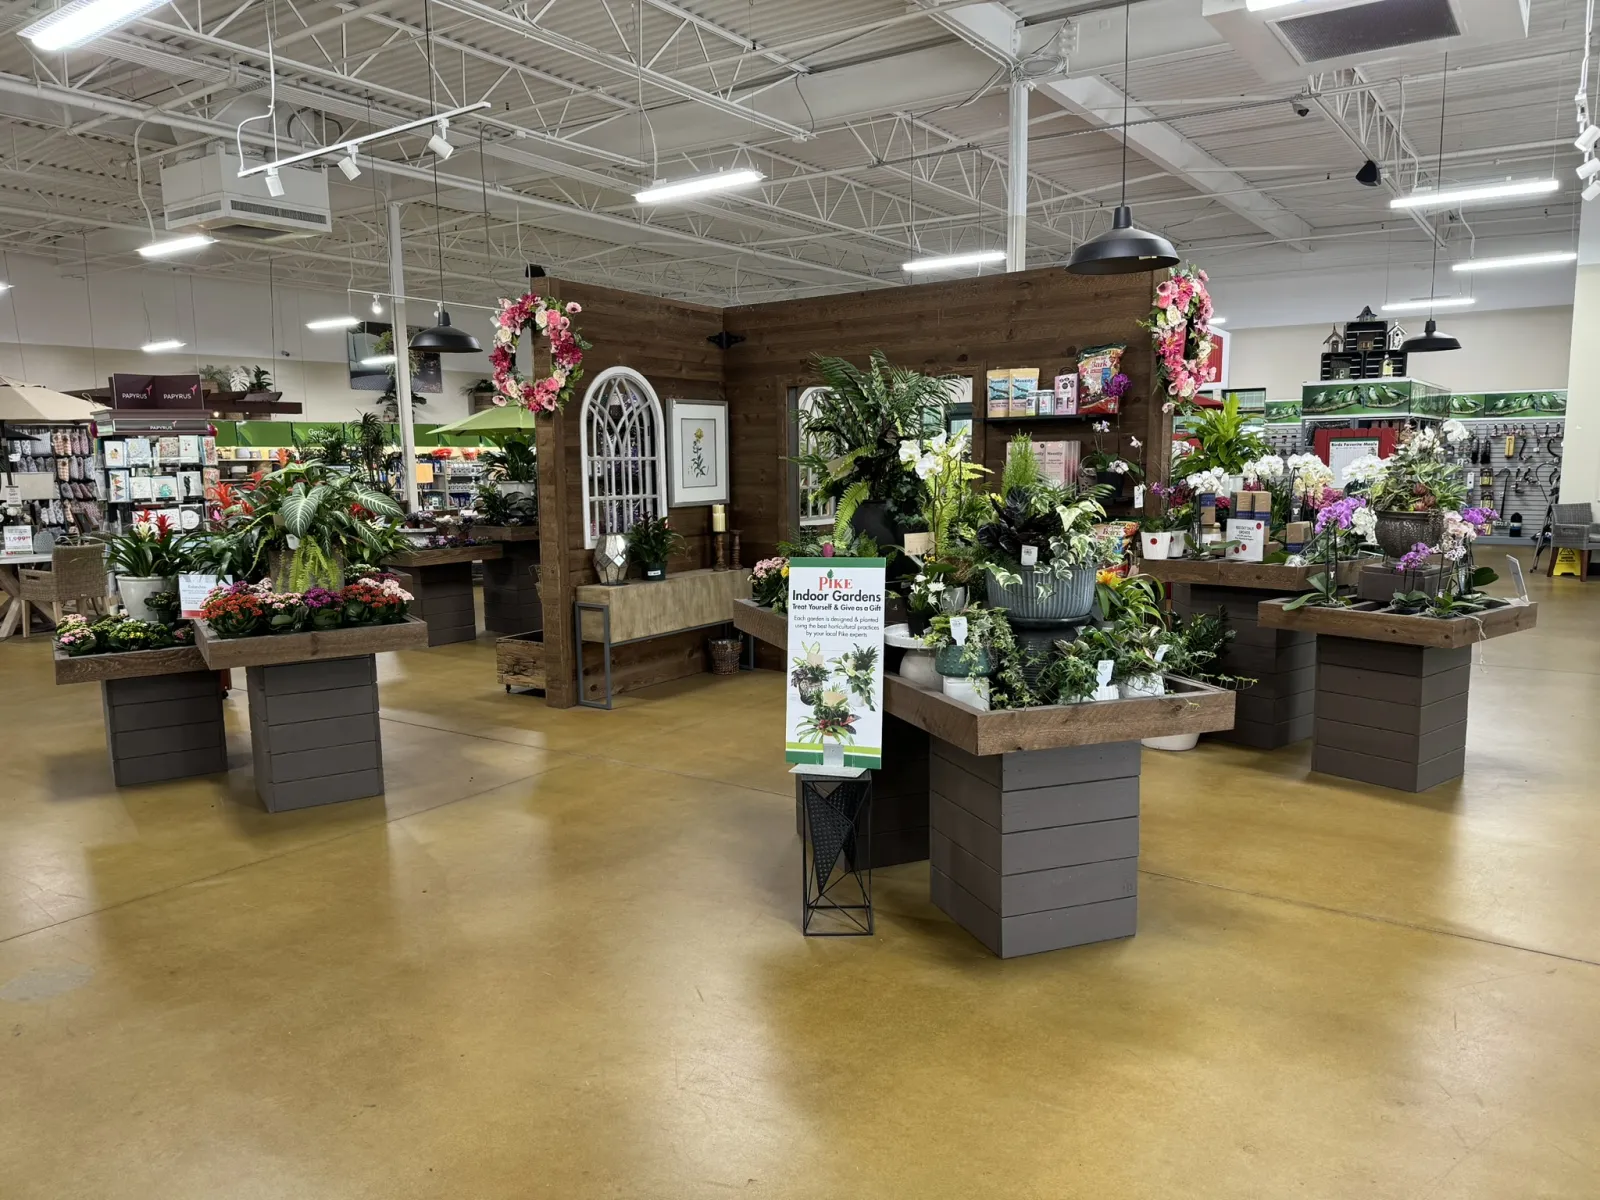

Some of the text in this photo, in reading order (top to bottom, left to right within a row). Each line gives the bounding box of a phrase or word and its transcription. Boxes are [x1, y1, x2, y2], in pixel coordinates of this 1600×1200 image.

[819, 576, 853, 591] PIKE
[792, 589, 881, 602] Indoor Gardens
[808, 603, 833, 611] Yourself
[869, 604, 881, 612] Gift
